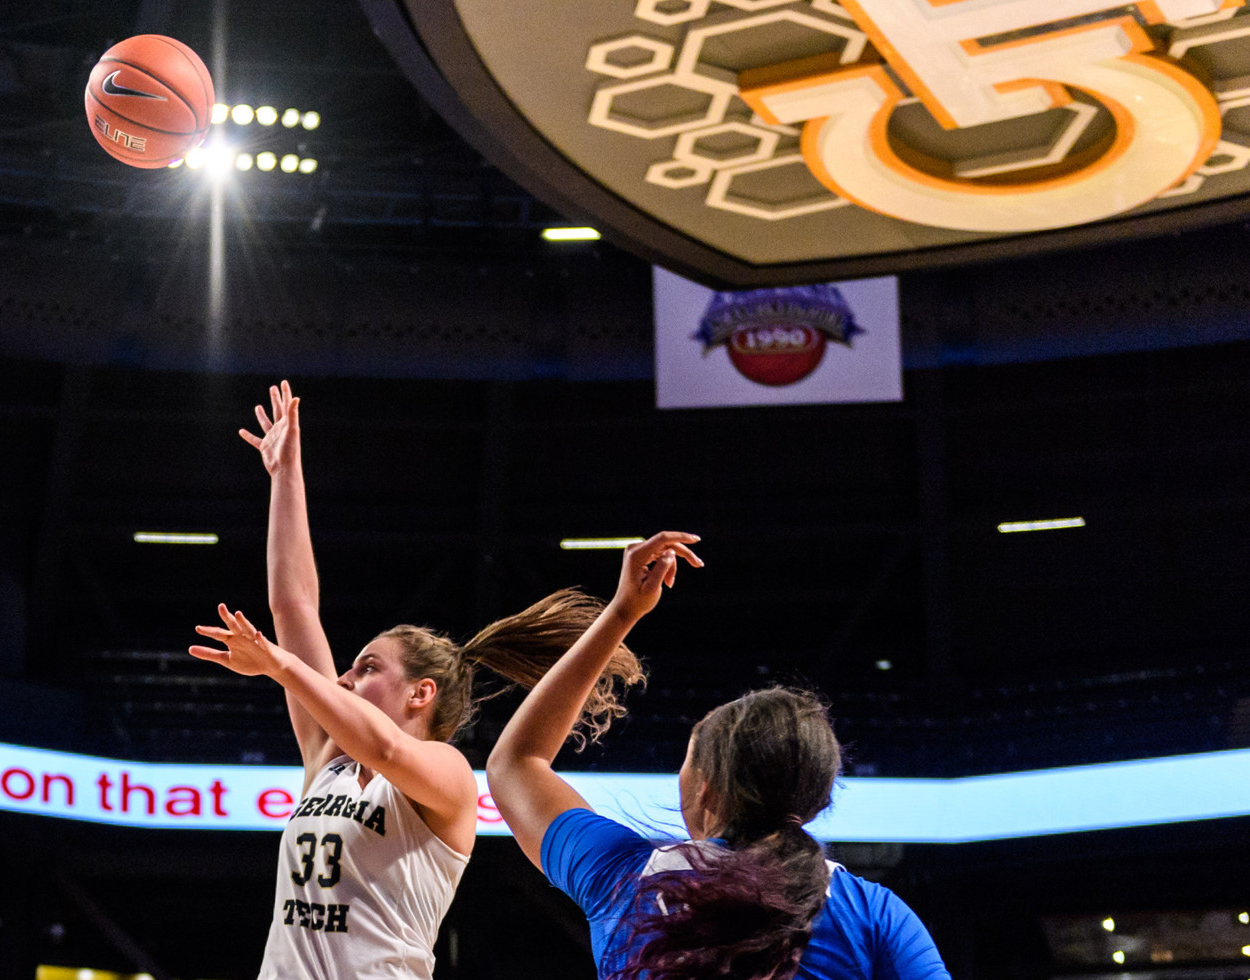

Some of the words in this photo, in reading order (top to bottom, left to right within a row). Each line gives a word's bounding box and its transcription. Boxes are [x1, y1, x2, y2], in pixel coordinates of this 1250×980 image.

[95, 113, 147, 152] ELITE
[97, 771, 229, 818] that
[291, 832, 345, 890] 33
[283, 899, 350, 934] TECH
